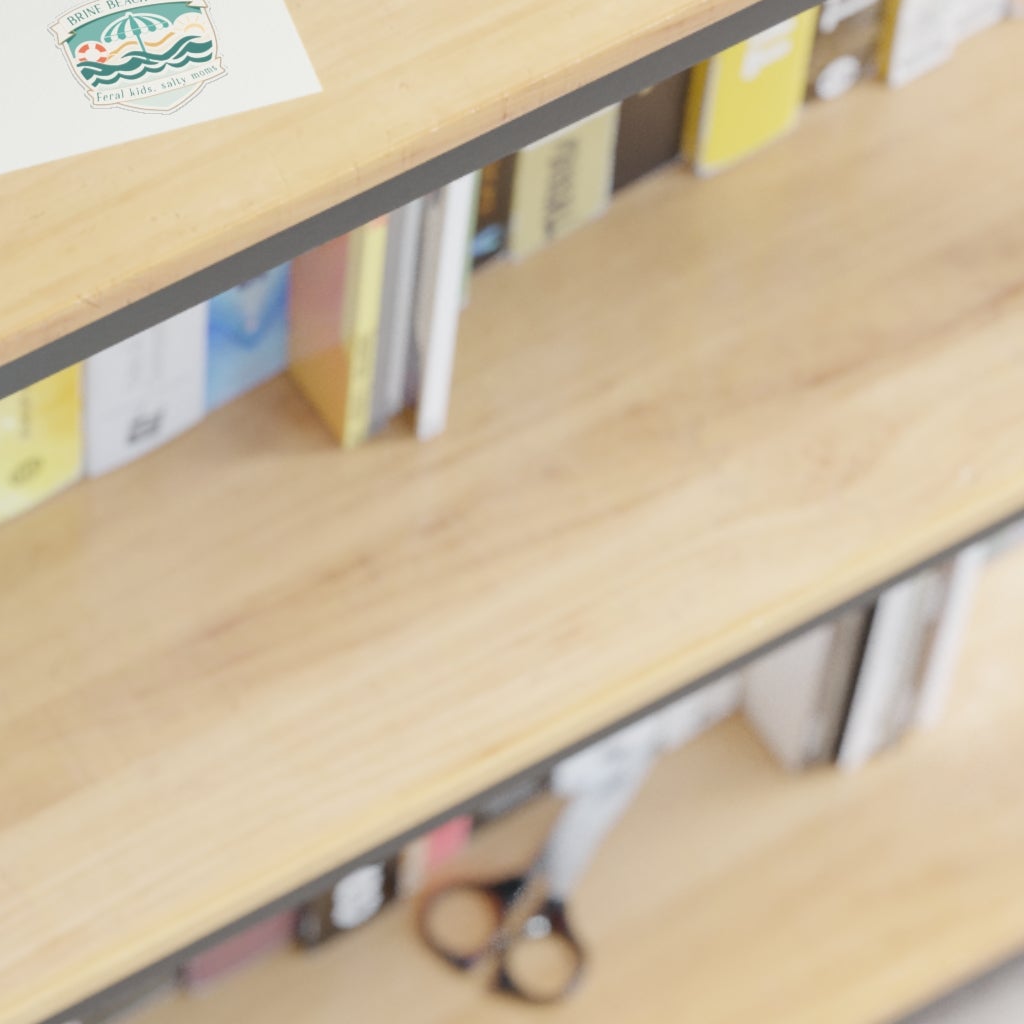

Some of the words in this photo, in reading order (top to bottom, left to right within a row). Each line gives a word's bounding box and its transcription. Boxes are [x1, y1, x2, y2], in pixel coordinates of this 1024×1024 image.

[66, 3, 105, 26] BRINE
[96, 90, 125, 102] Feral
[160, 77, 187, 89] salty
[190, 65, 218, 79] moms
